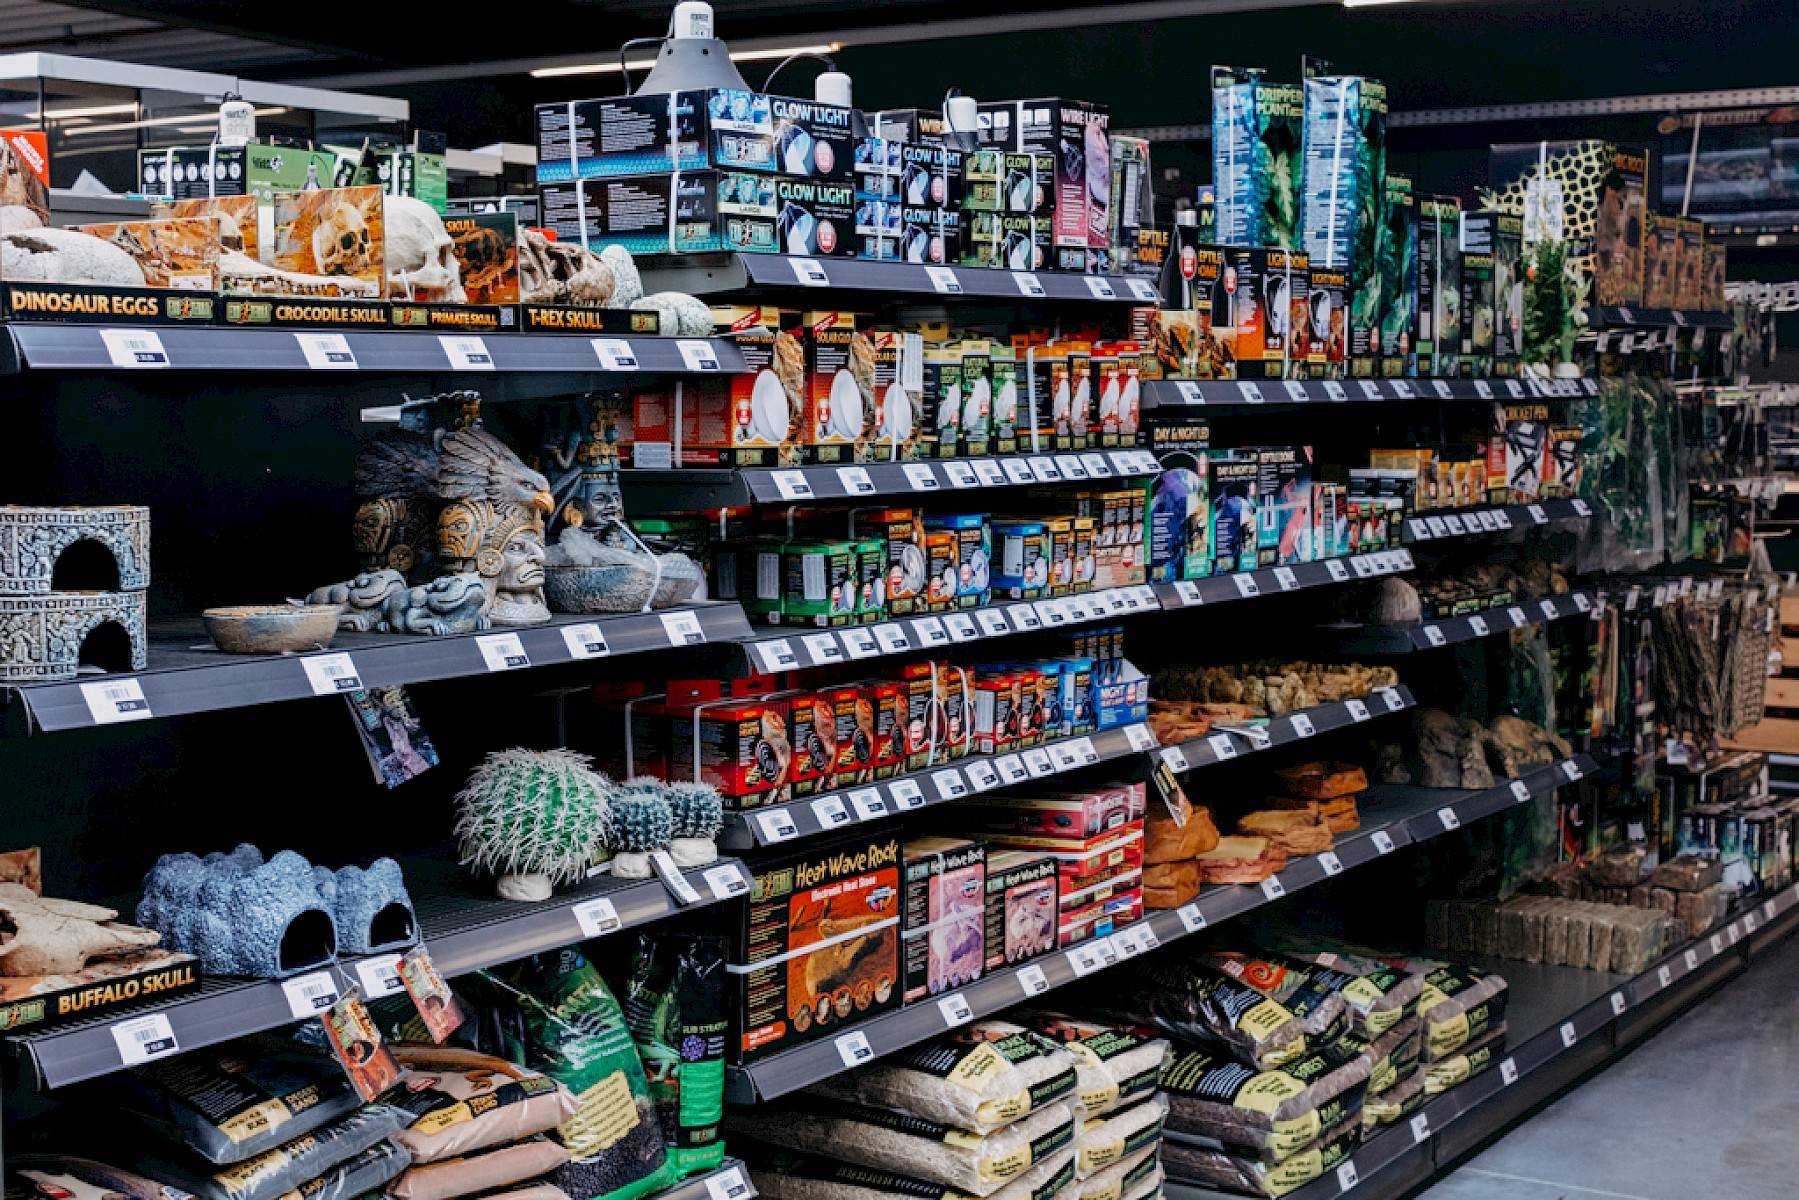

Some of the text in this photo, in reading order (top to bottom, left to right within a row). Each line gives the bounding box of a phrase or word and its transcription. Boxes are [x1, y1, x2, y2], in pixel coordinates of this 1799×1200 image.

[773, 101, 851, 126] GLOW LIGHT
[779, 182, 853, 205] GLOW LIGHT
[1138, 230, 1169, 246] EPTILE
[1199, 250, 1222, 265] EPTILE
[12, 291, 108, 314] DINOSAUR
[112, 296, 158, 316] EGGS
[276, 306, 349, 322] CROCODILE
[351, 308, 388, 324] SKULL
[431, 311, 498, 326] PRIMATE SKULL
[529, 309, 604, 329] T-REX SKULL
[796, 860, 827, 888] Heat
[829, 851, 866, 875] Wave
[868, 839, 897, 868] Rock
[58, 966, 195, 1015] BUFFALO SKULL
